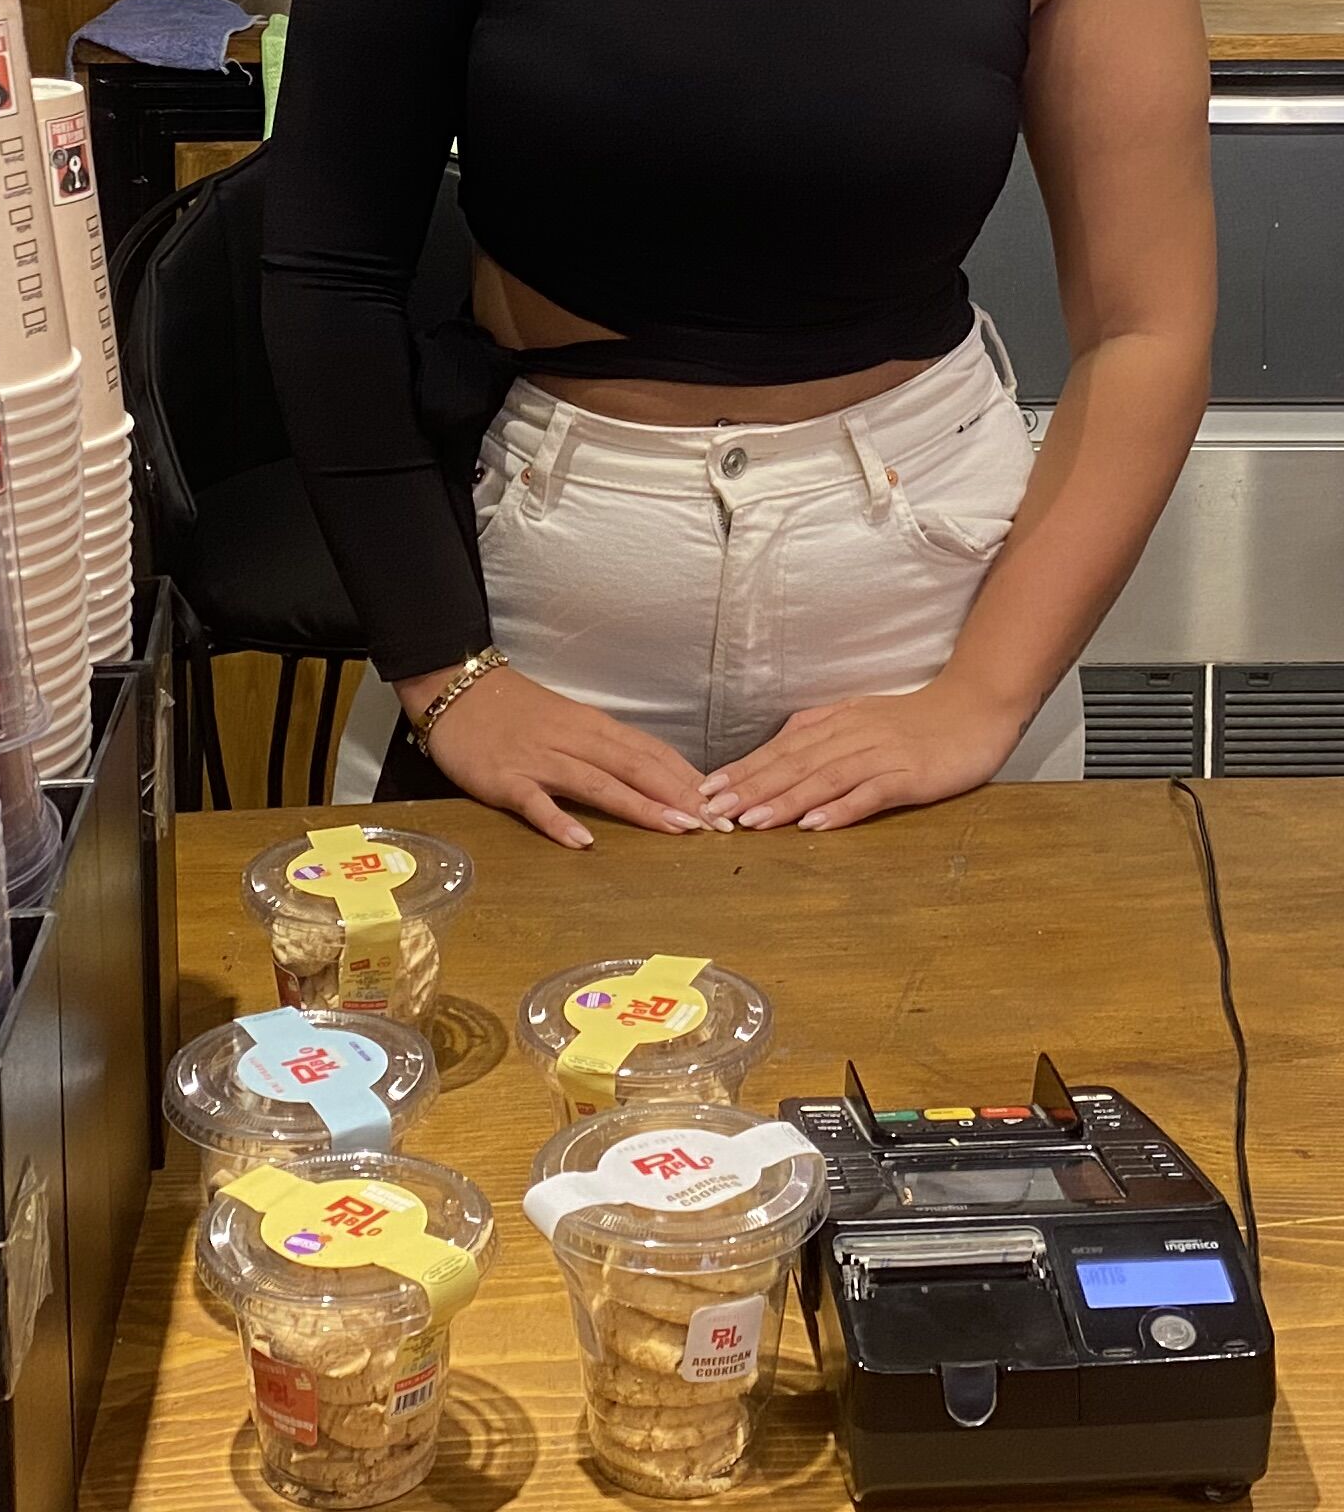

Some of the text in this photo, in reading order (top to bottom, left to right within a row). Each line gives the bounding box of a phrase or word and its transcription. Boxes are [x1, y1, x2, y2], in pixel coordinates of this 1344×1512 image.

[665, 1174, 740, 1203] AMERICAN
[1164, 1239, 1219, 1253] ingenico
[692, 1350, 752, 1367] AMERICAN
[696, 1362, 746, 1378] COOKIES
